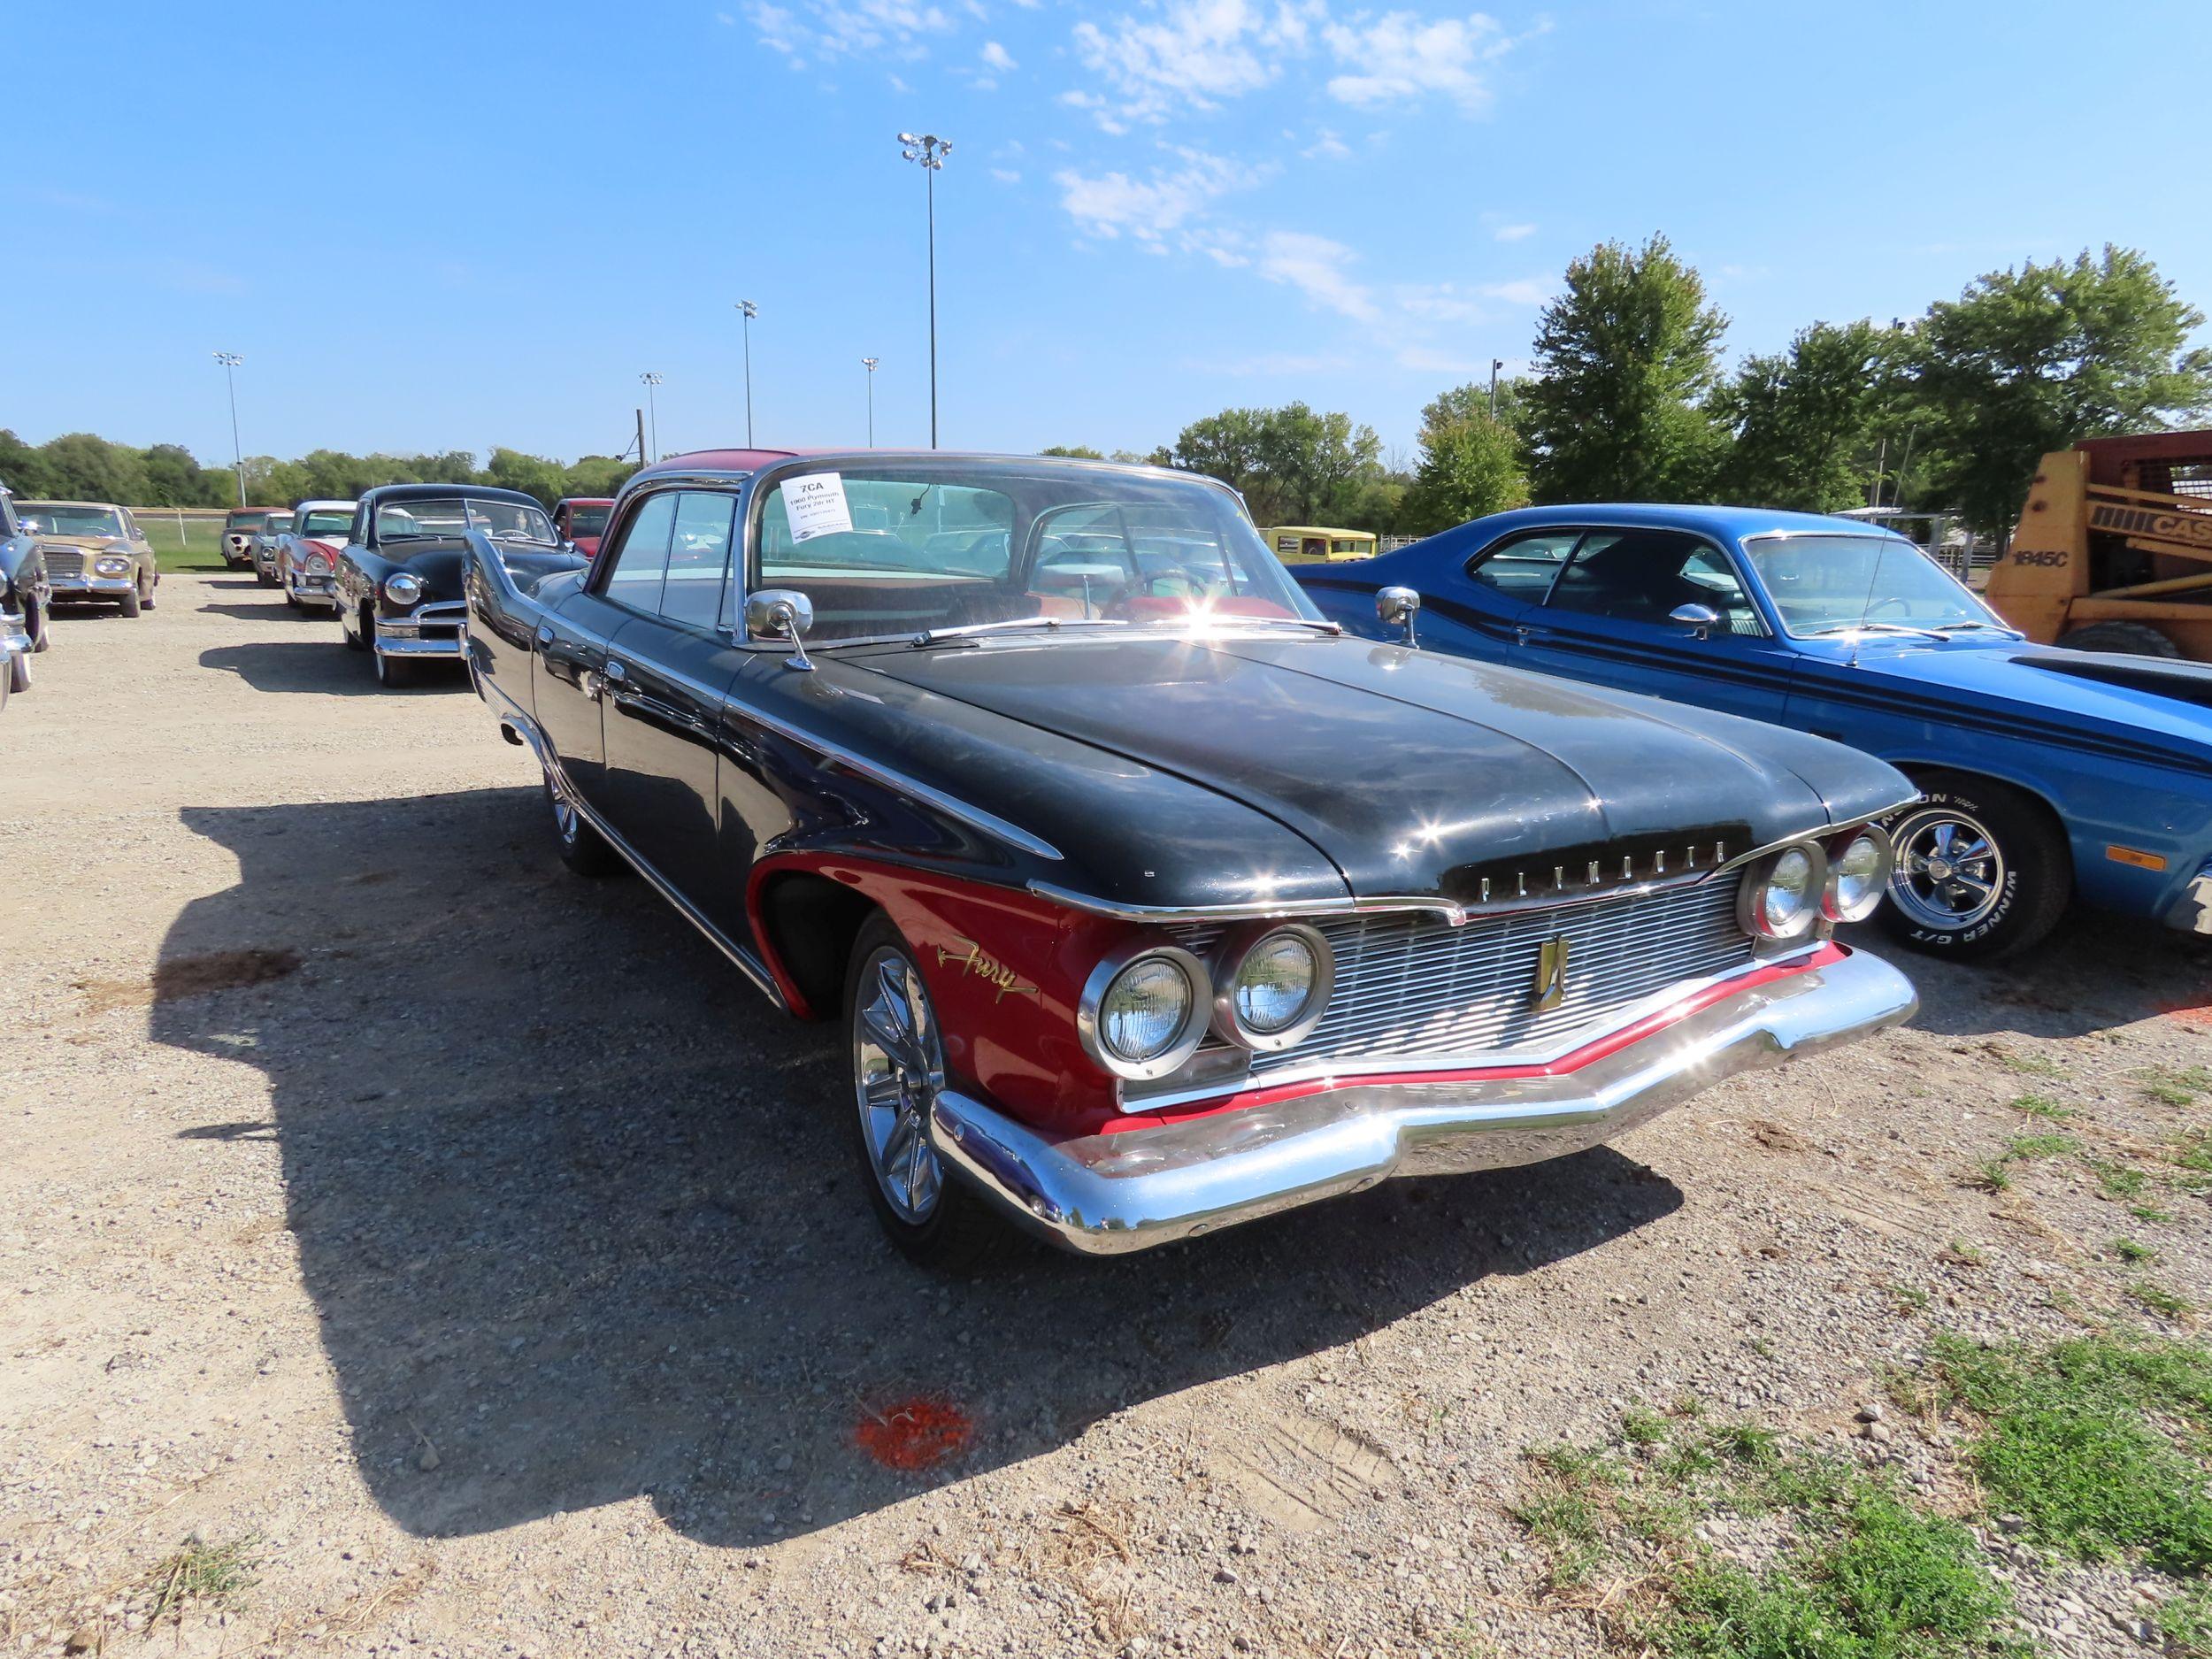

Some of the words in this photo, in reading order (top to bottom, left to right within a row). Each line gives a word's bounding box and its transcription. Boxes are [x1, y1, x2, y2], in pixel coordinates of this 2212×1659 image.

[800, 482, 824, 493] 7CA
[790, 496, 806, 505] 1960
[807, 491, 840, 501] Plymouth
[2012, 550, 2069, 567] 1845C
[1480, 841, 1724, 903] PLYMOUTH
[1963, 871, 2017, 942] WINNER
[1910, 930, 1953, 944] G/T
[936, 934, 1040, 1005] Fury
